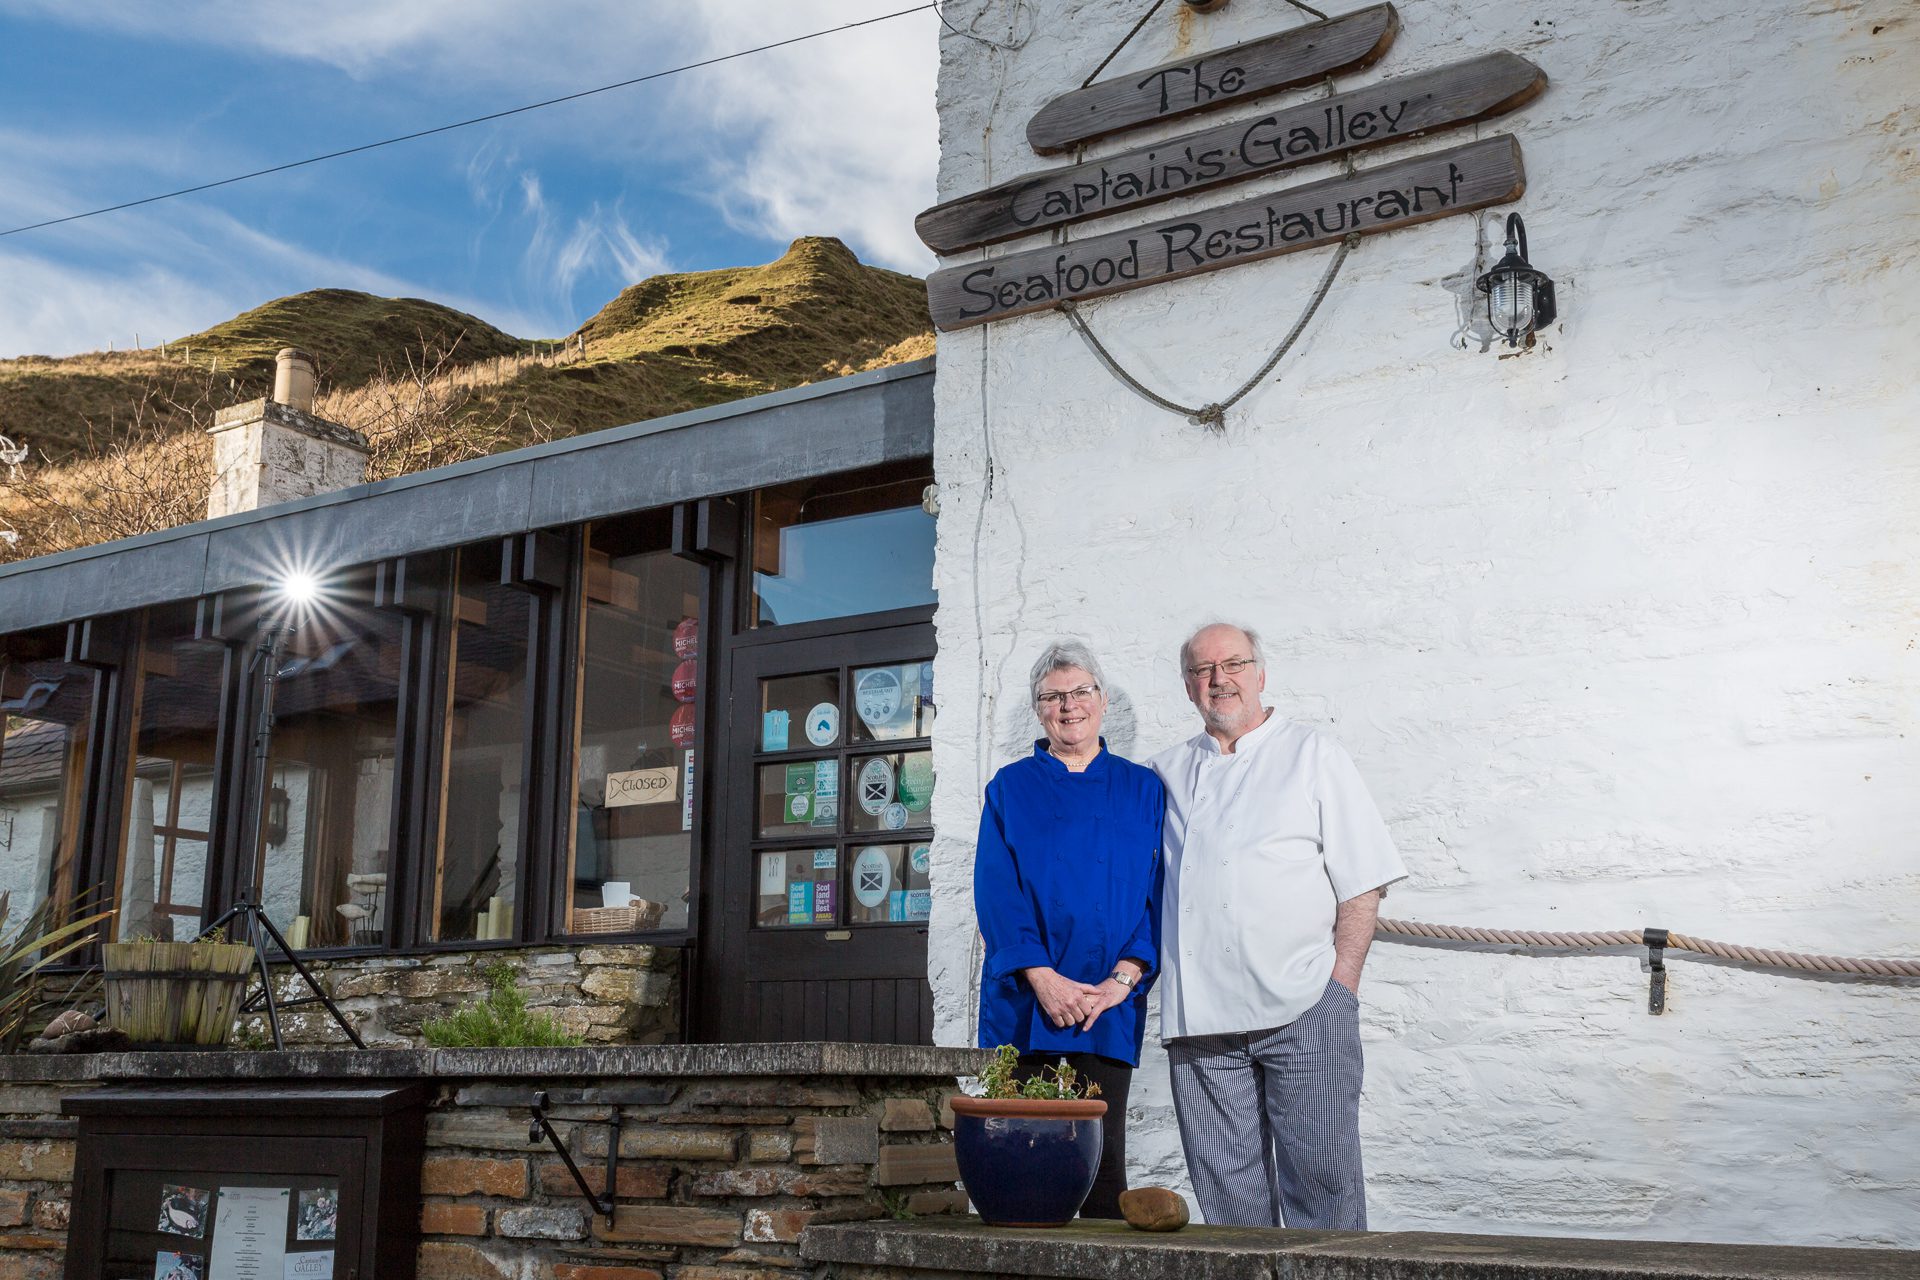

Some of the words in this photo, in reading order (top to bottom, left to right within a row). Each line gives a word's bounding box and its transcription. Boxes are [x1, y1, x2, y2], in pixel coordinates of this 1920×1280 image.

[1137, 63, 1246, 114] The
[1008, 145, 1226, 227] Captain's
[1239, 100, 1410, 168] Galley
[958, 239, 1139, 319] Seafood
[1157, 163, 1465, 274] Restaurant
[675, 637, 698, 647] MICHEL
[674, 681, 697, 690] MICHEL
[672, 725, 696, 735] MICHEL
[622, 777, 668, 791] CLOSED
[815, 883, 830, 891] Scot
[815, 904, 830, 912] Best
